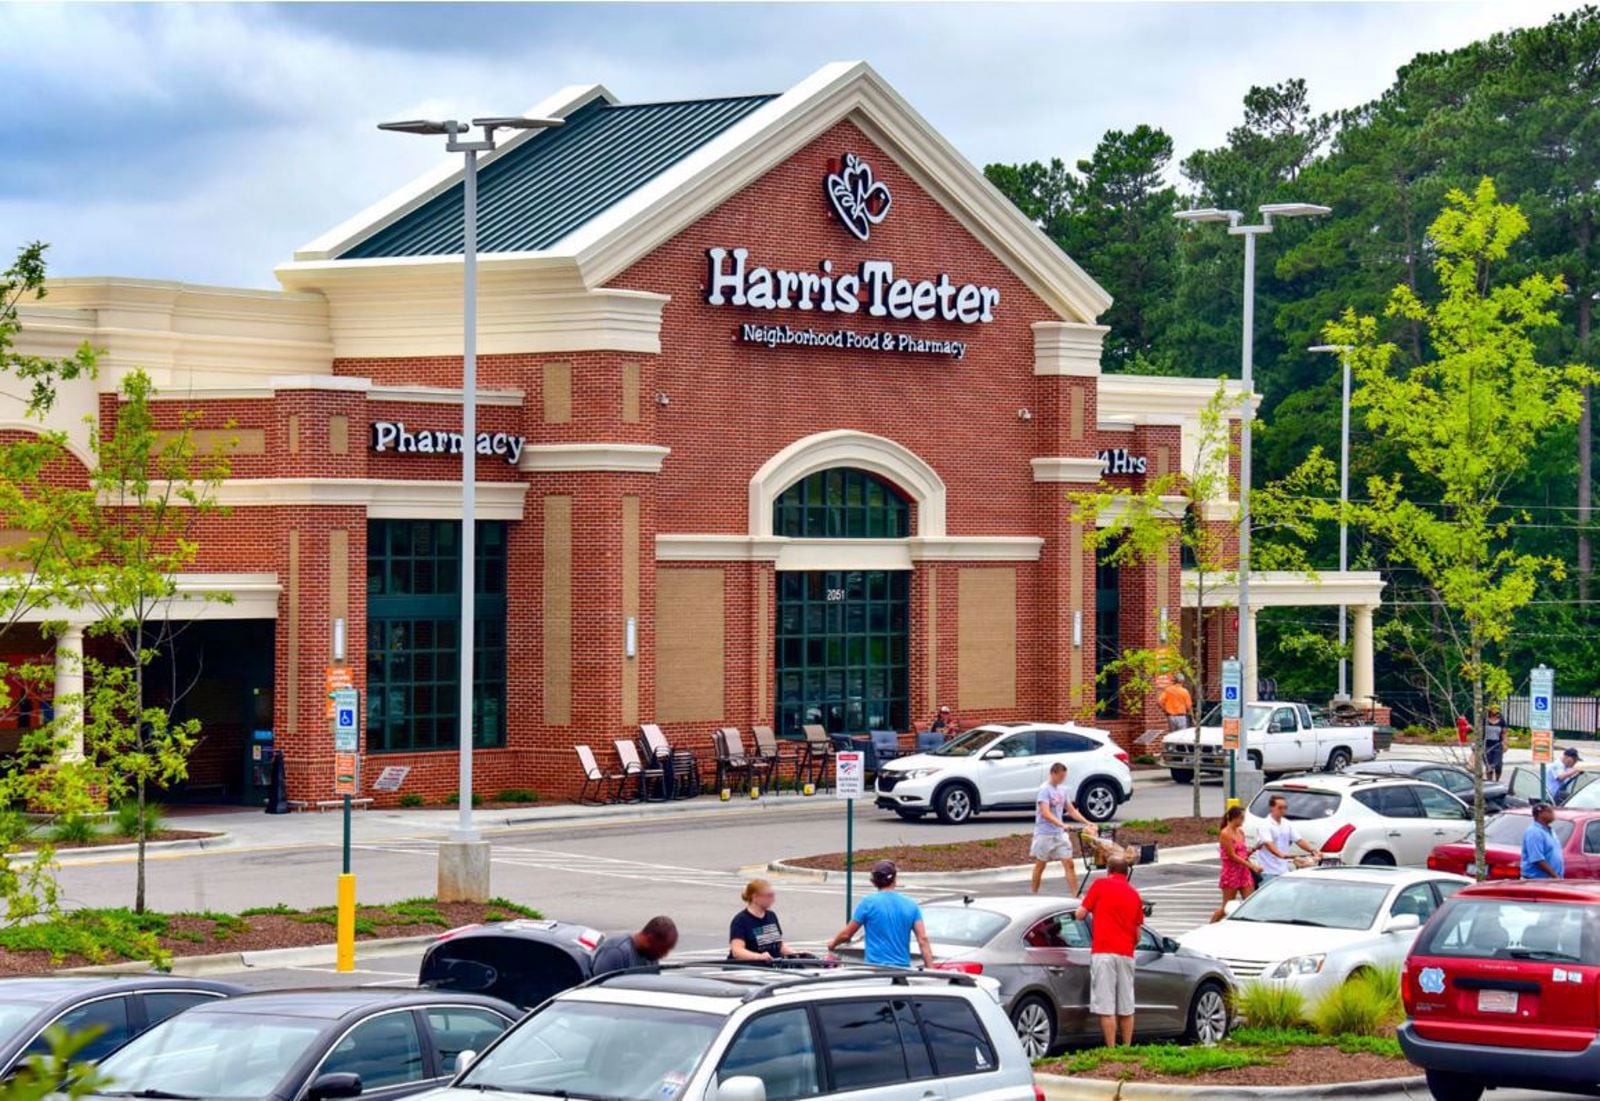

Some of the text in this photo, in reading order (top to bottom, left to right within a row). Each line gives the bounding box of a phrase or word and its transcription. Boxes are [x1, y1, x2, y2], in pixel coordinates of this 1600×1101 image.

[708, 247, 1000, 324] Harris Teeter
[743, 323, 967, 360] Neighborhood Food & Pharmacy
[1112, 448, 1147, 474] Hrs
